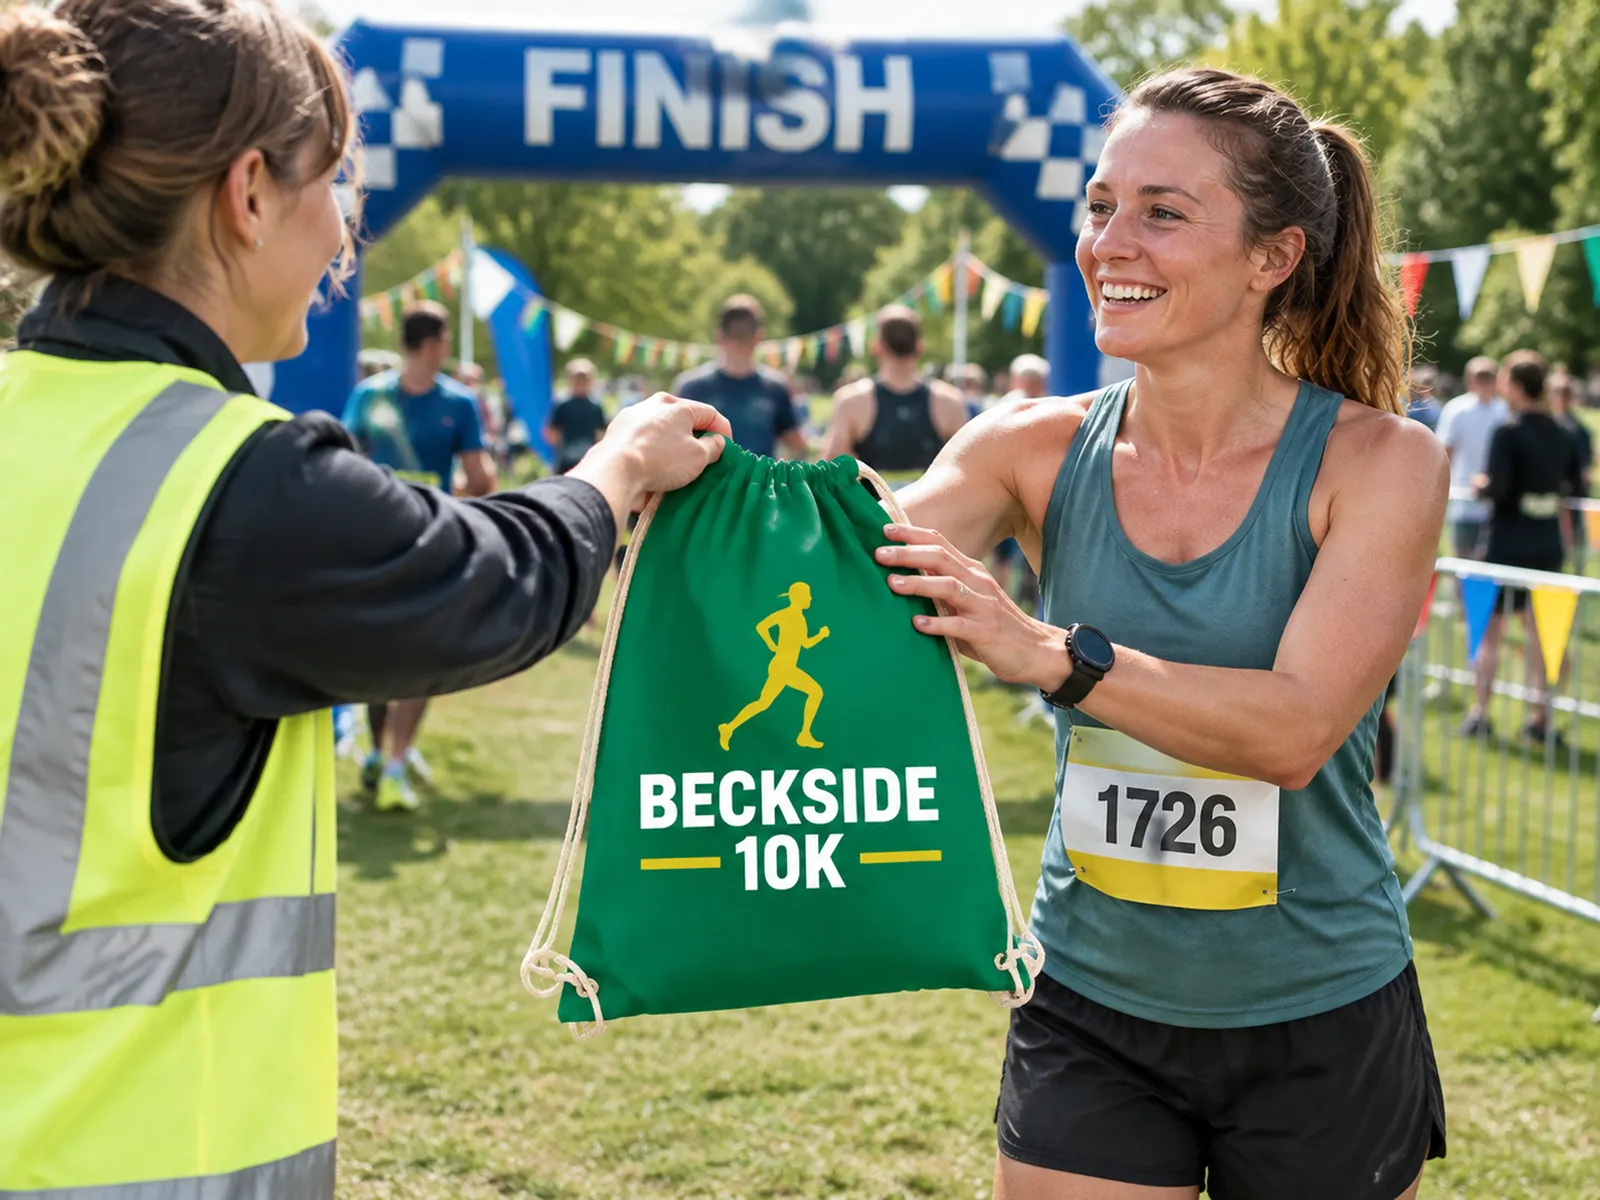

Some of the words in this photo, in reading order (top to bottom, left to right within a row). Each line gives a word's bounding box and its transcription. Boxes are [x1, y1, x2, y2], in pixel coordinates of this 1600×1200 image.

[524, 47, 913, 152] FINISH
[640, 766, 939, 829] BECKSIDE
[1098, 784, 1236, 857] 1726
[735, 833, 846, 890] 10K
